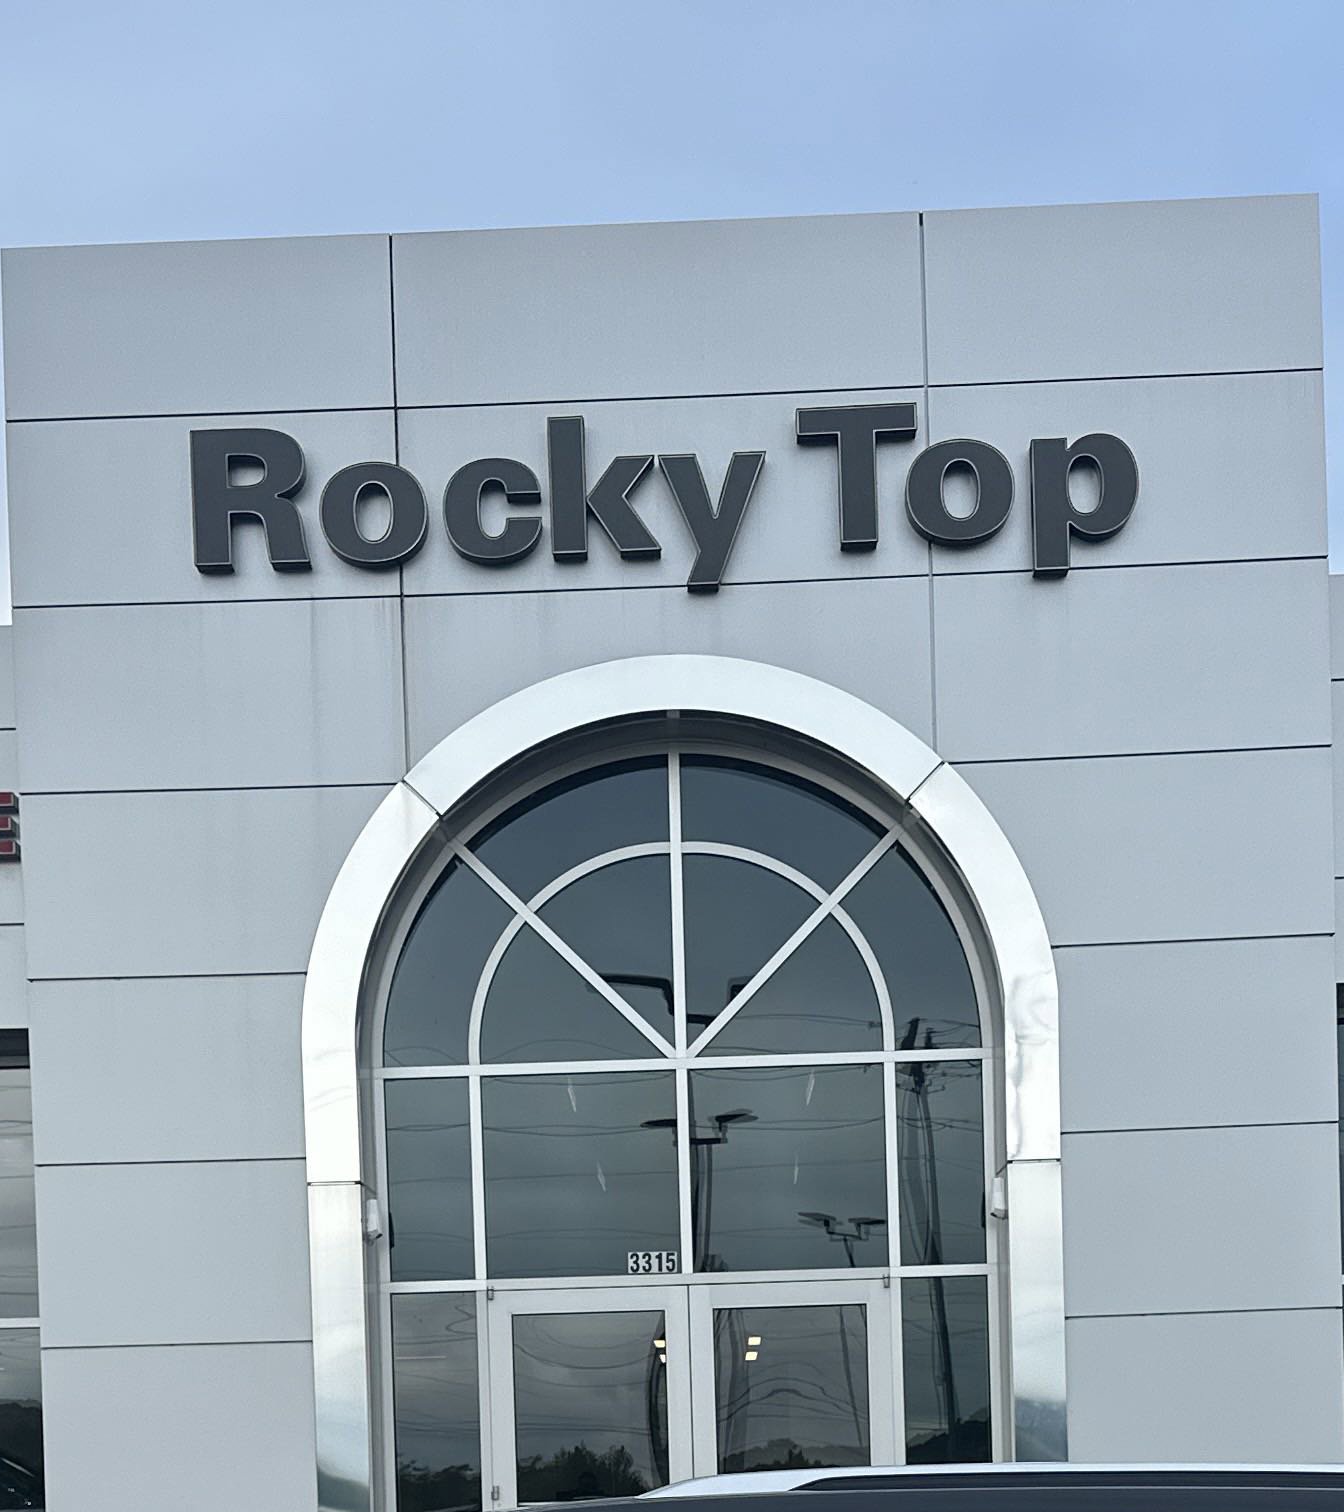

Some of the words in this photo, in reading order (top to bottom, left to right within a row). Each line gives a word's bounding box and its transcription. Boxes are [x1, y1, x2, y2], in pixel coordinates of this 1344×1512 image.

[188, 415, 765, 592] Rocky
[795, 402, 1139, 579] Top
[629, 1252, 677, 1273] 3315
